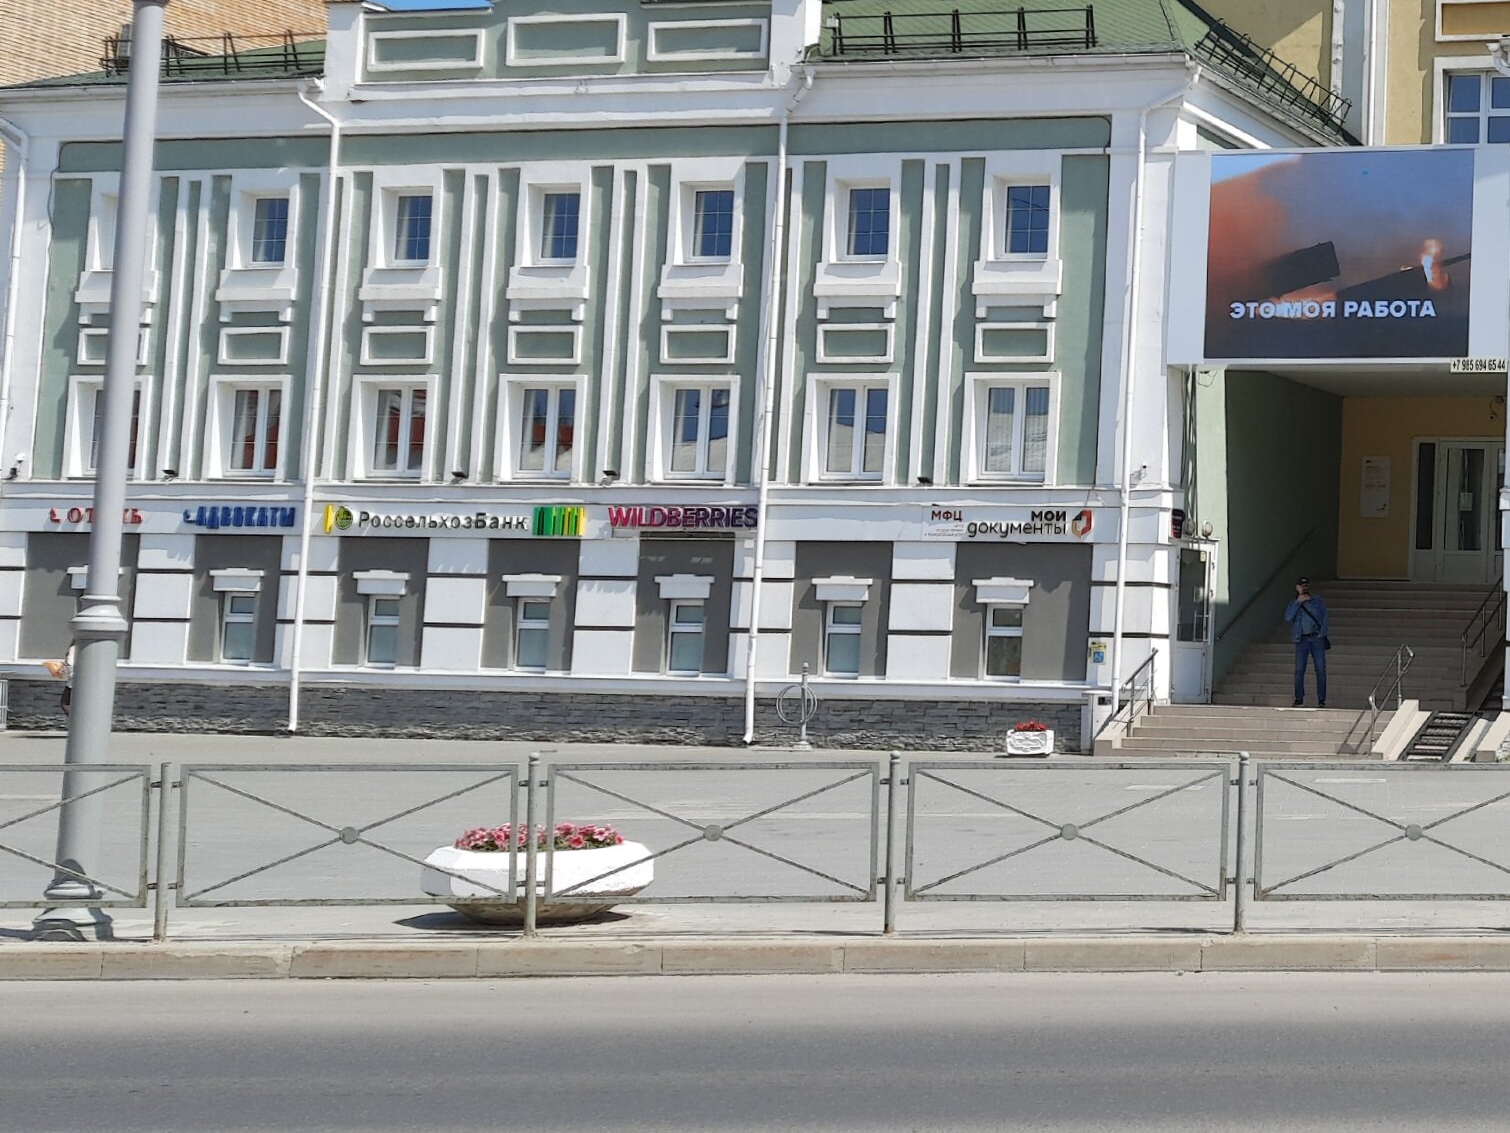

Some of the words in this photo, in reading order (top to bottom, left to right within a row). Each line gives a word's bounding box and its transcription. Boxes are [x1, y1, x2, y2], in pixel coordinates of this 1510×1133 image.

[1230, 301, 1276, 318] ЭТО
[1283, 301, 1336, 318] МОЯ
[1344, 300, 1437, 318] РАБОТА
[1453, 359, 1461, 370] +7
[1488, 359, 1497, 370] 65
[1497, 359, 1506, 370] 44
[67, 507, 143, 524] ОТЬ
[196, 506, 296, 529] АДВОКАТЫ
[358, 510, 529, 531] РоссельхозБанк
[608, 506, 758, 528] WILDBERRIES
[931, 510, 963, 522] МФЦ
[967, 522, 1067, 538] документы
